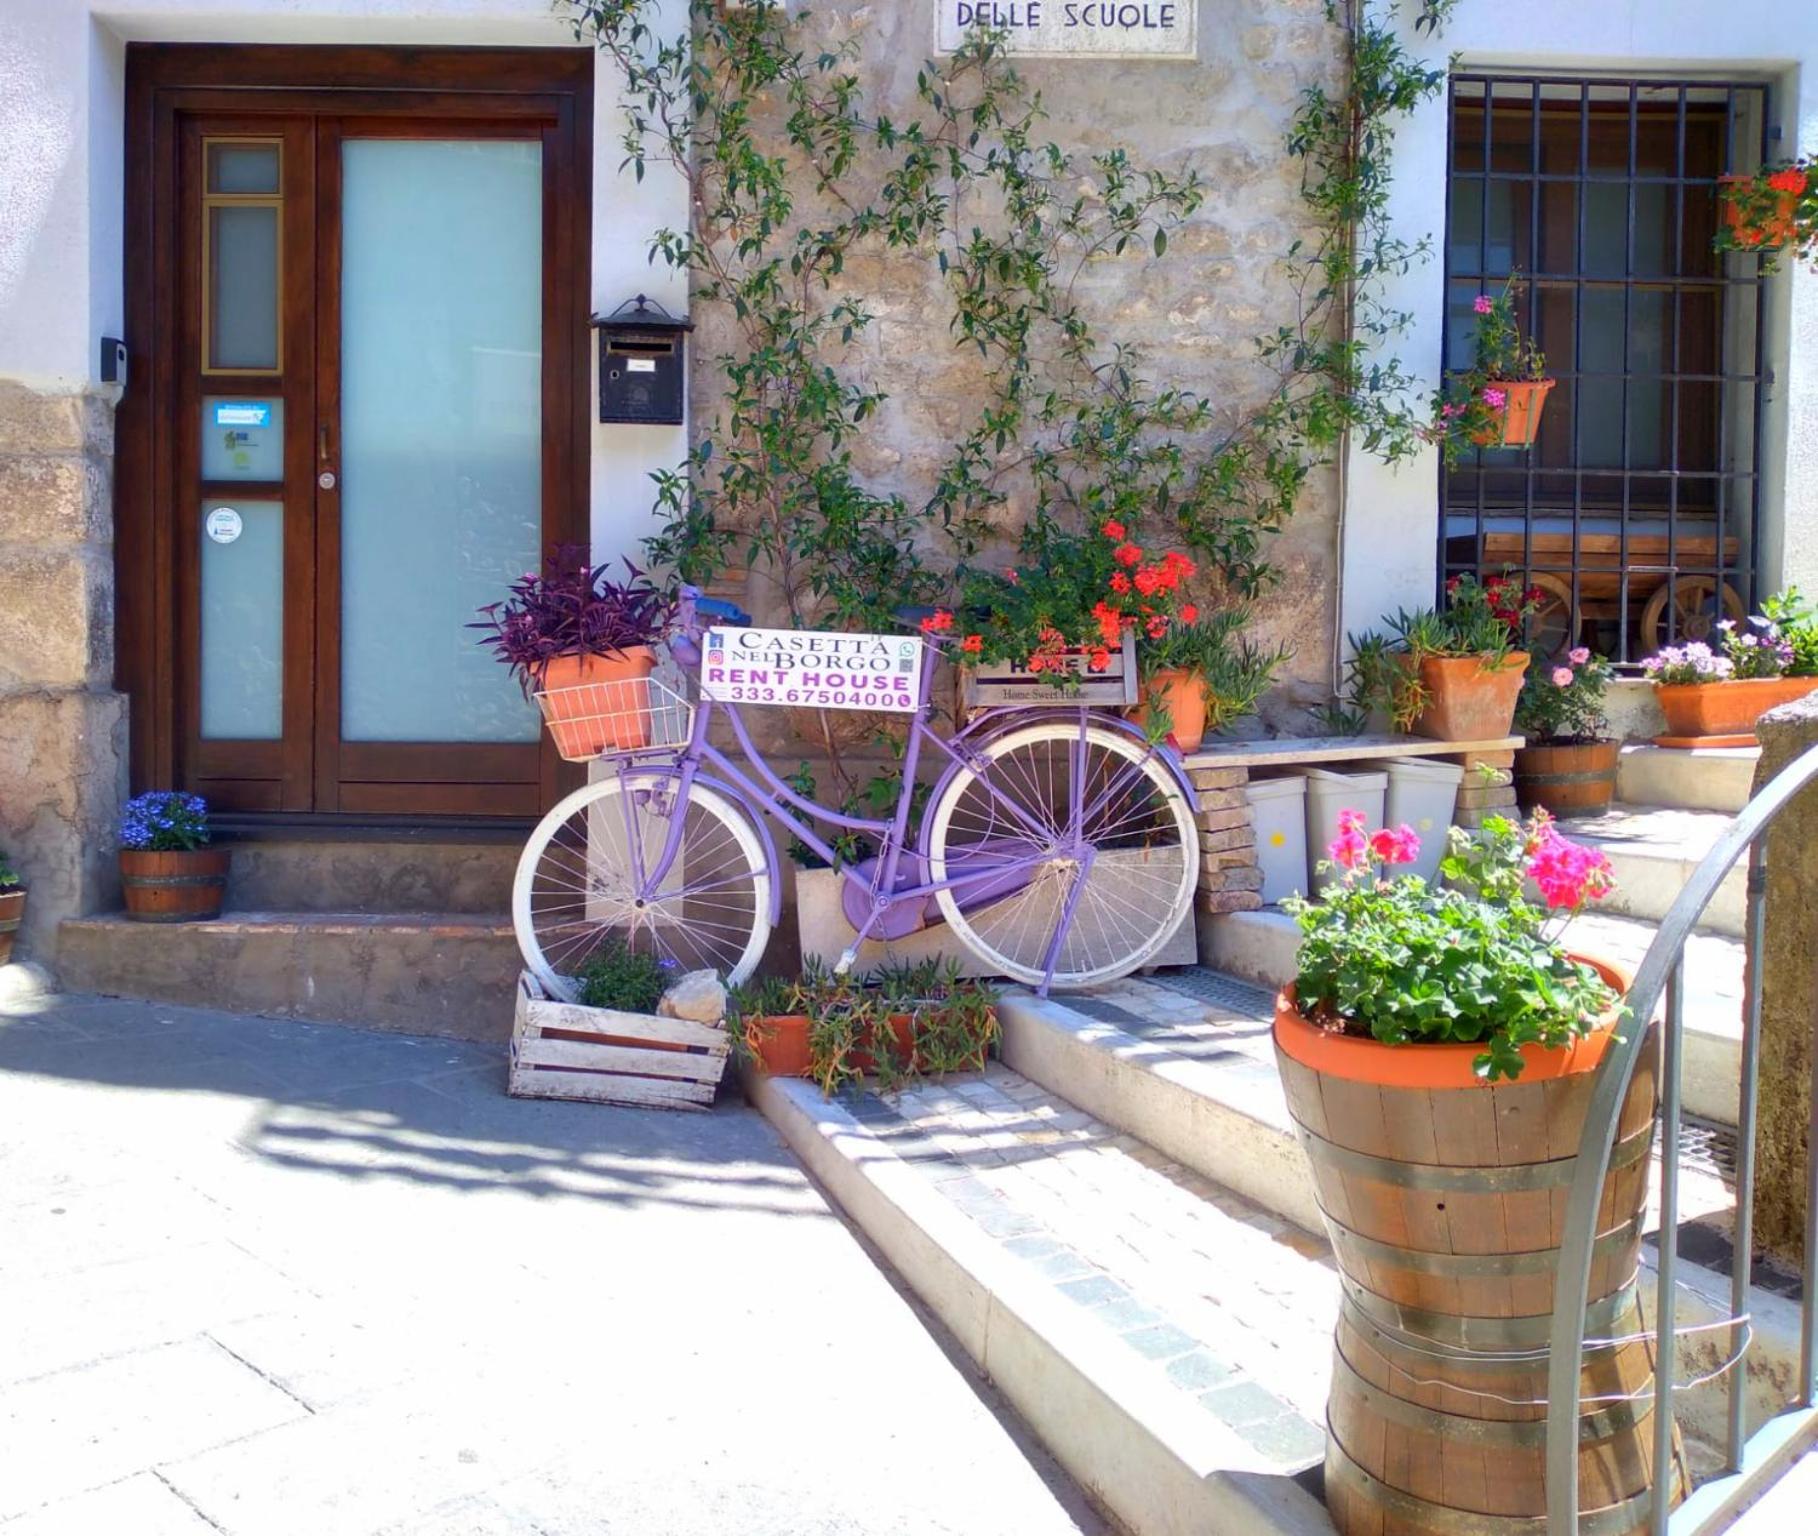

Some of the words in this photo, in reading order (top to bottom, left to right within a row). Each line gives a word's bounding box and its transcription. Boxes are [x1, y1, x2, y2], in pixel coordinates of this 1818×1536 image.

[957, 2, 1041, 27] DELLE
[1063, 4, 1175, 29] SCUOLE
[739, 632, 890, 655] CASETTA
[731, 650, 774, 663] NEL
[774, 652, 891, 672] BORGO
[708, 668, 789, 685] RENT
[802, 671, 909, 691] HOUSE
[731, 686, 894, 707] 333.6750400
[1003, 688, 1030, 700] Home
[1032, 688, 1058, 700] Sweet
[1061, 687, 1089, 700] Hme
